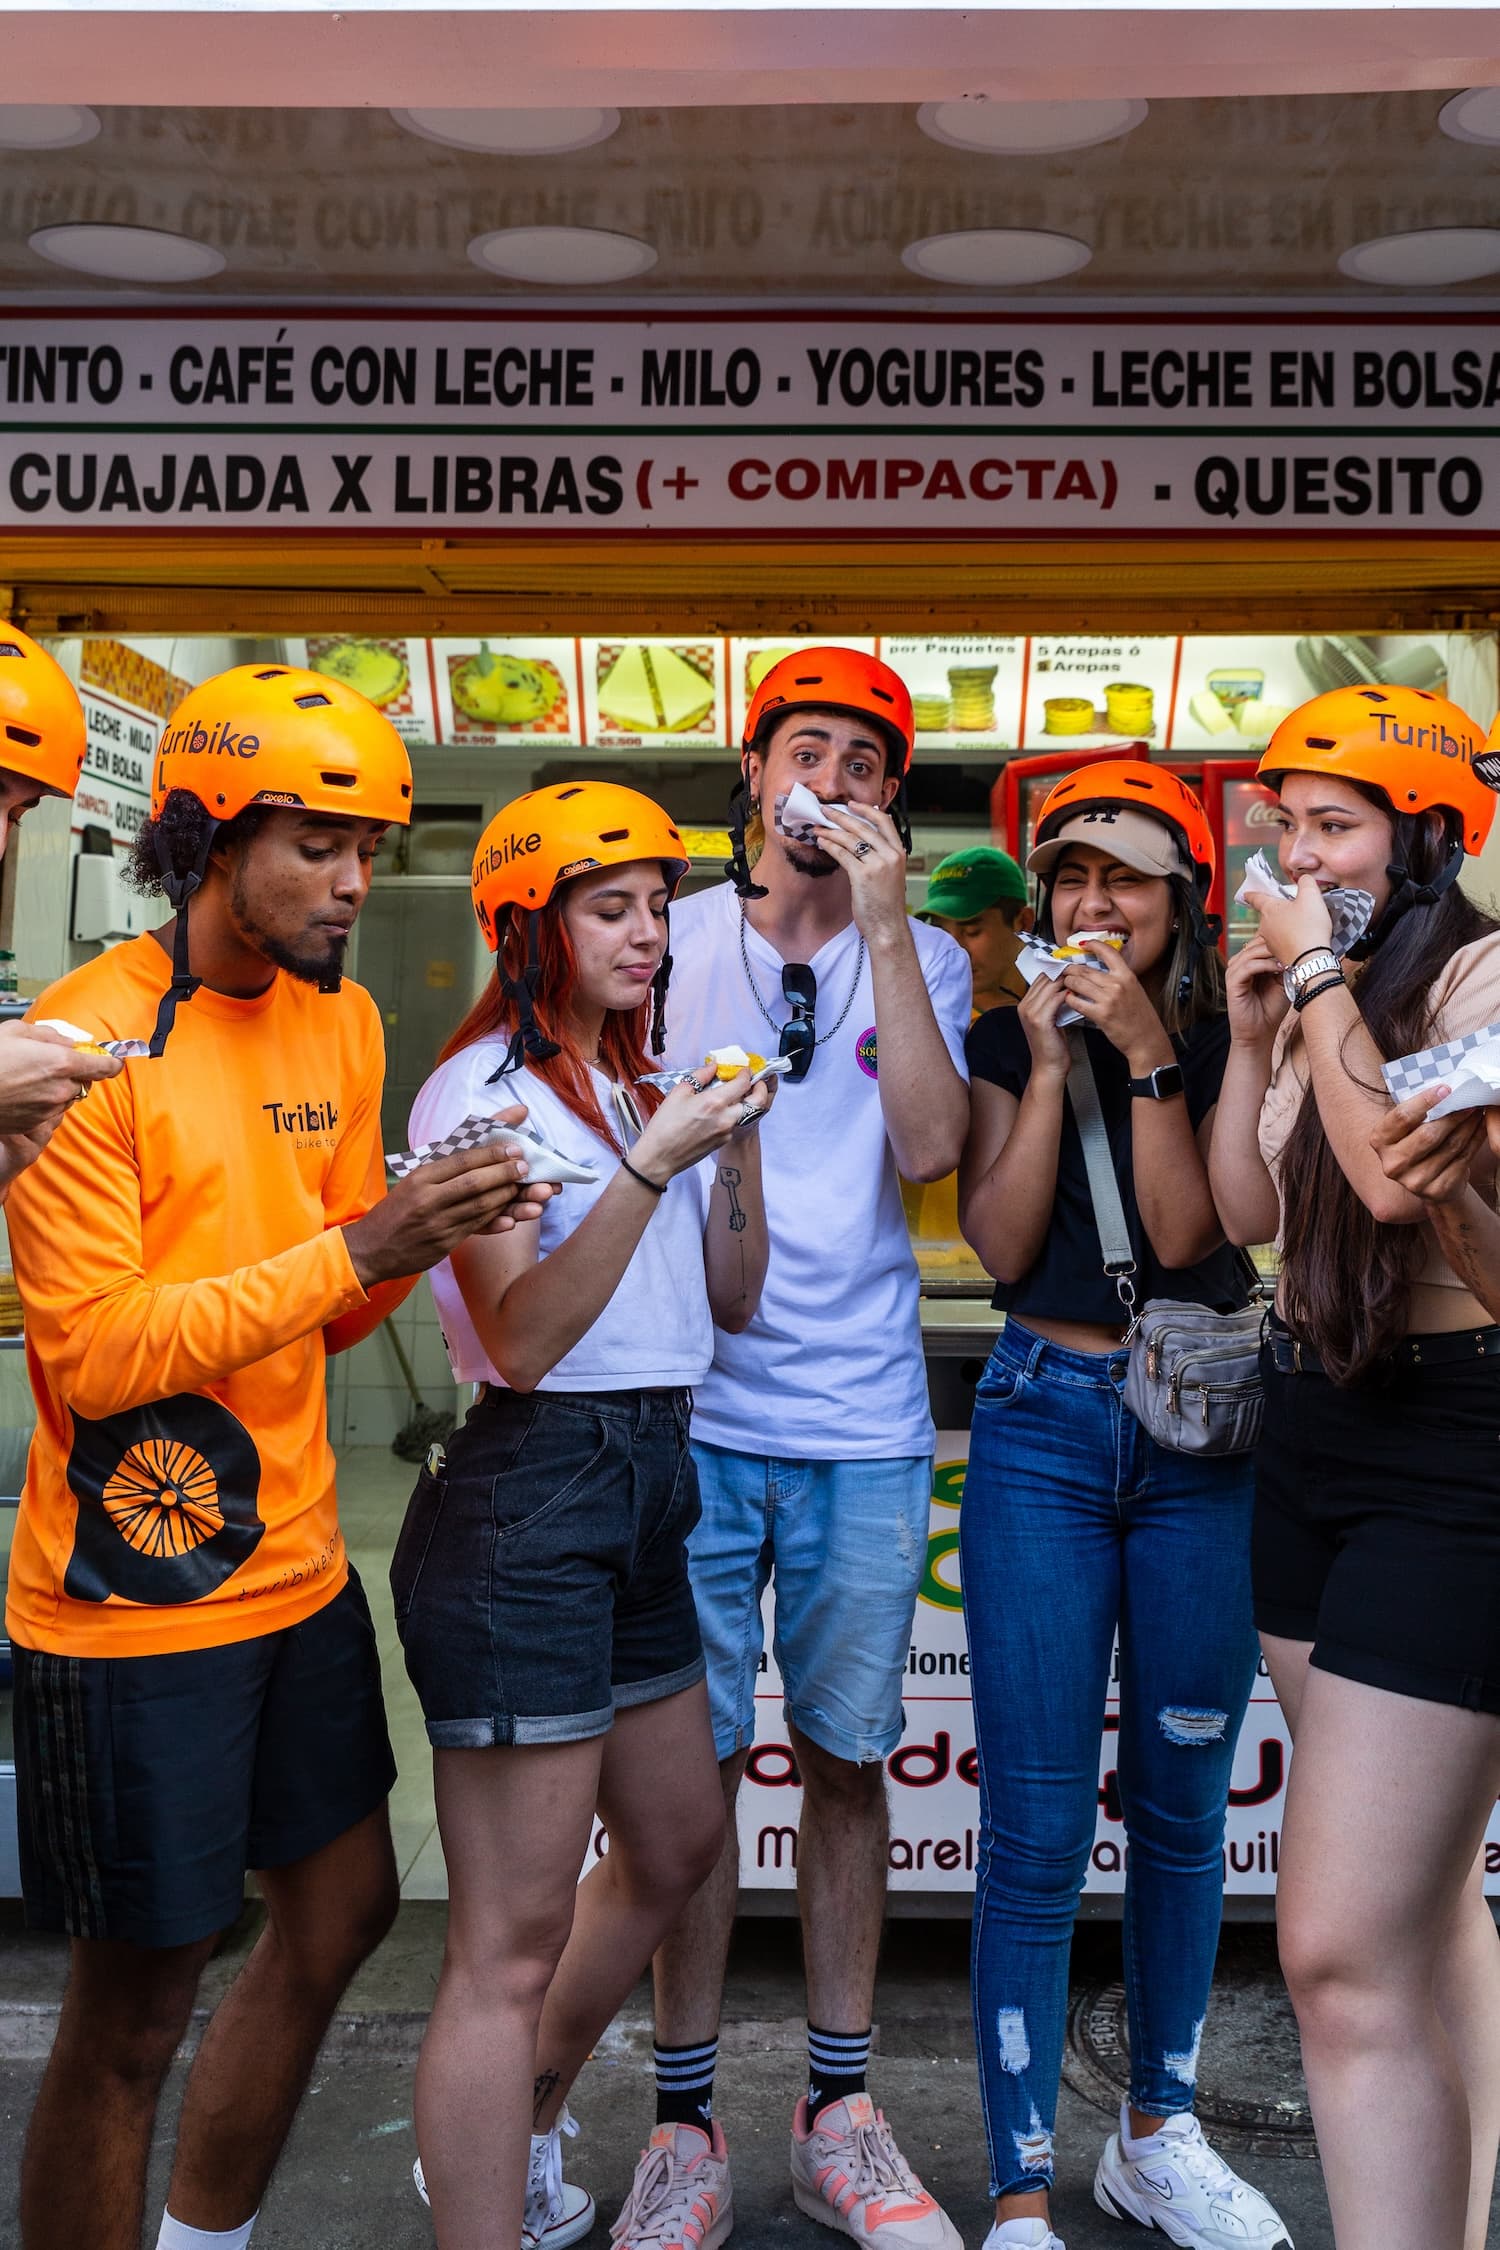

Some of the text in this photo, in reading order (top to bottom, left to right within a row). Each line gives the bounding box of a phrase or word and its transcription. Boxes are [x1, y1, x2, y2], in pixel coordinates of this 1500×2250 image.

[169, 328, 294, 405] CAFÉ
[310, 346, 417, 405] CON
[434, 347, 594, 406] LECHE
[641, 348, 761, 406] MILO
[806, 348, 1045, 407] YOGURES
[1092, 350, 1253, 408] LECHE
[1270, 351, 1335, 408] EN
[9, 453, 309, 513] CUAJADA
[329, 456, 372, 513] X
[394, 455, 624, 515] LIBRAS
[727, 458, 1119, 511] COMPACTA)
[1194, 455, 1483, 519] QUESITO
[926, 644, 1016, 654] Paquetes
[1054, 661, 1121, 674] Arepas
[1055, 645, 1122, 658] Arepas
[88, 708, 153, 753] LECHE MILO
[1369, 713, 1482, 767] Turibik
[96, 747, 109, 772] EN
[112, 753, 144, 784] BOLSA
[472, 833, 541, 887] uribike
[262, 1101, 338, 1134] Turibik
[296, 1138, 322, 1150] bike
